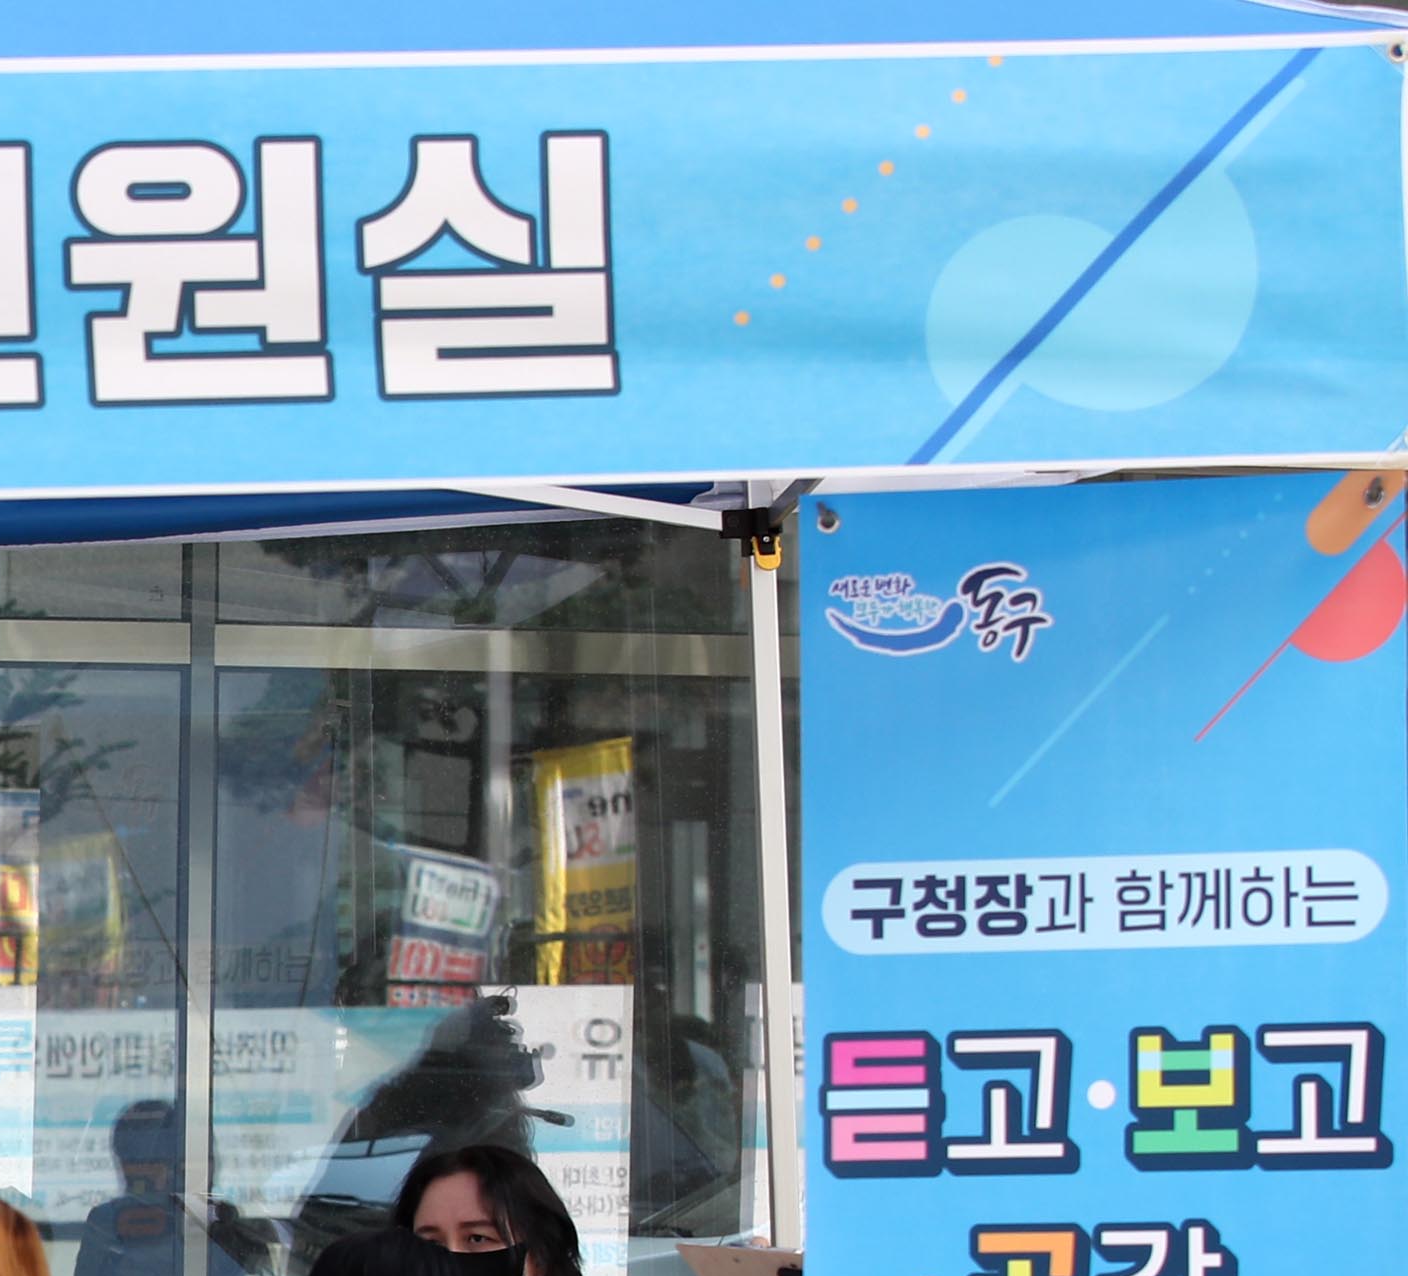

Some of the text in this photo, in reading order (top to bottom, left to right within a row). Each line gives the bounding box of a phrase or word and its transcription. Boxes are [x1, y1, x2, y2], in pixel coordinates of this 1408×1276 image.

[958, 563, 1052, 662] 동구
[850, 865, 1359, 940] 구청장과 함께하는
